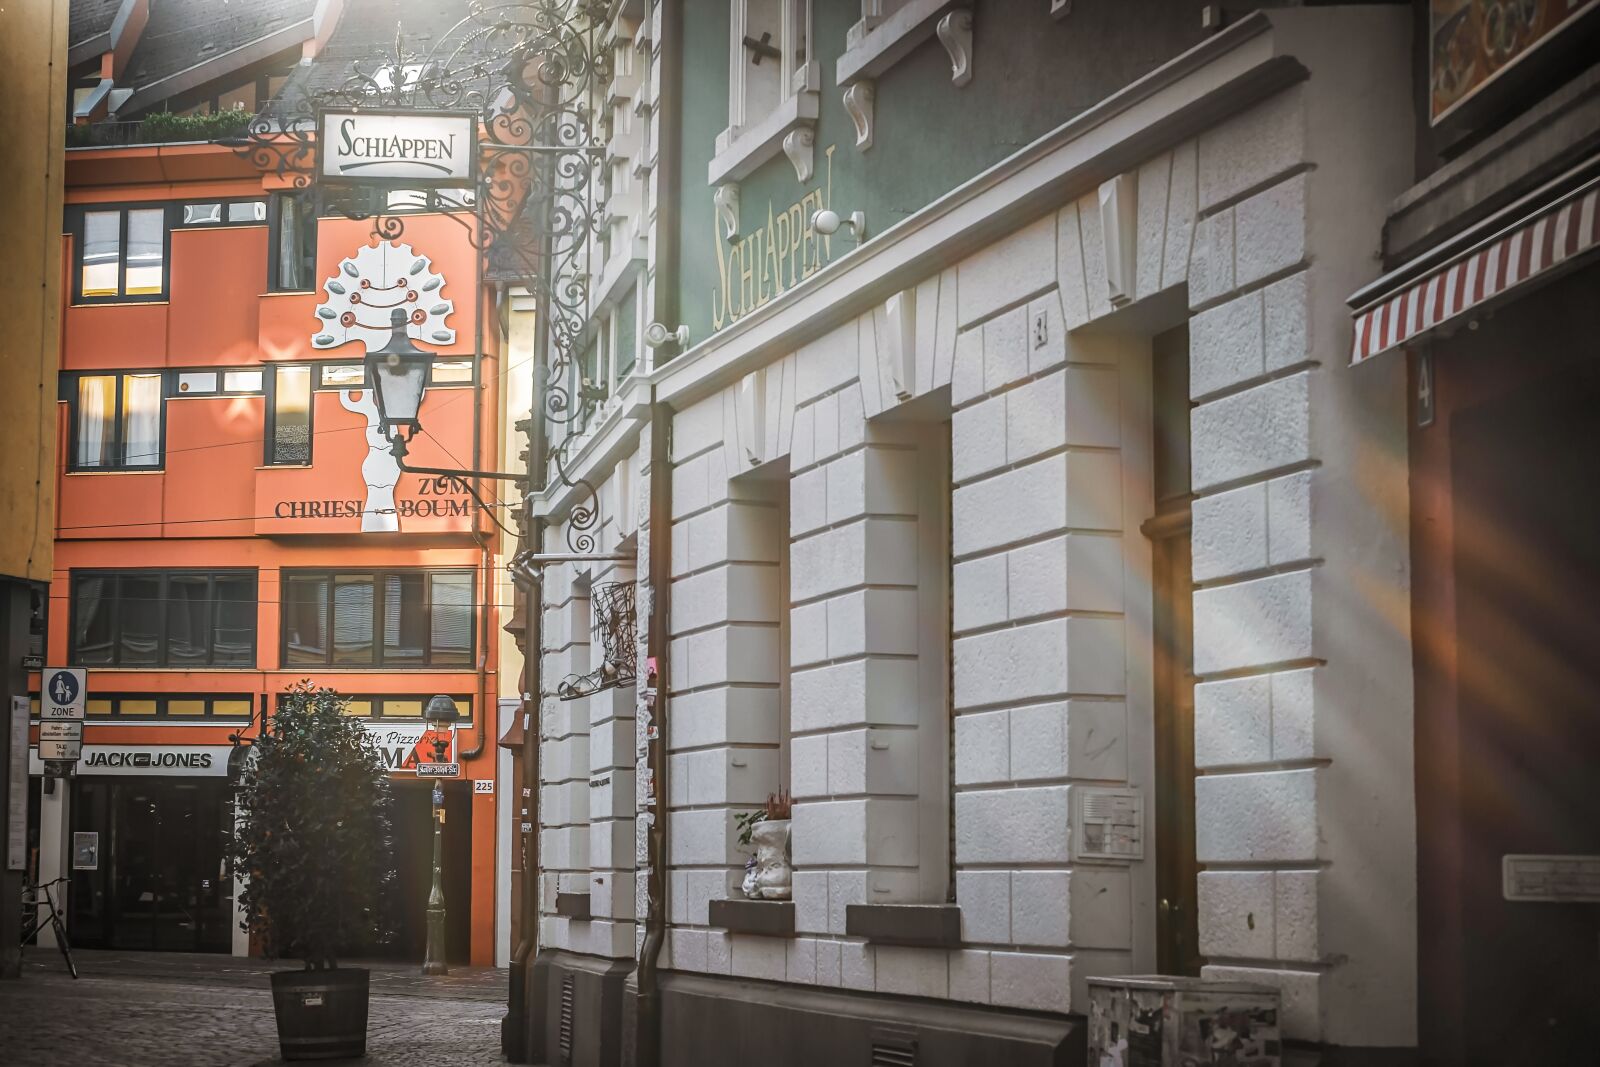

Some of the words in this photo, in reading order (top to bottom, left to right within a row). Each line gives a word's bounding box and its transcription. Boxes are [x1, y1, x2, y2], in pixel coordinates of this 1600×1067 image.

[338, 118, 456, 159] SCHLAPPEN
[418, 477, 470, 496] ZUM
[275, 500, 363, 519] CHRIESI
[401, 499, 471, 518] BOUM
[51, 707, 75, 717] ZONE
[85, 752, 133, 766] JACK
[151, 752, 212, 768] JONES
[475, 782, 492, 791] 225
